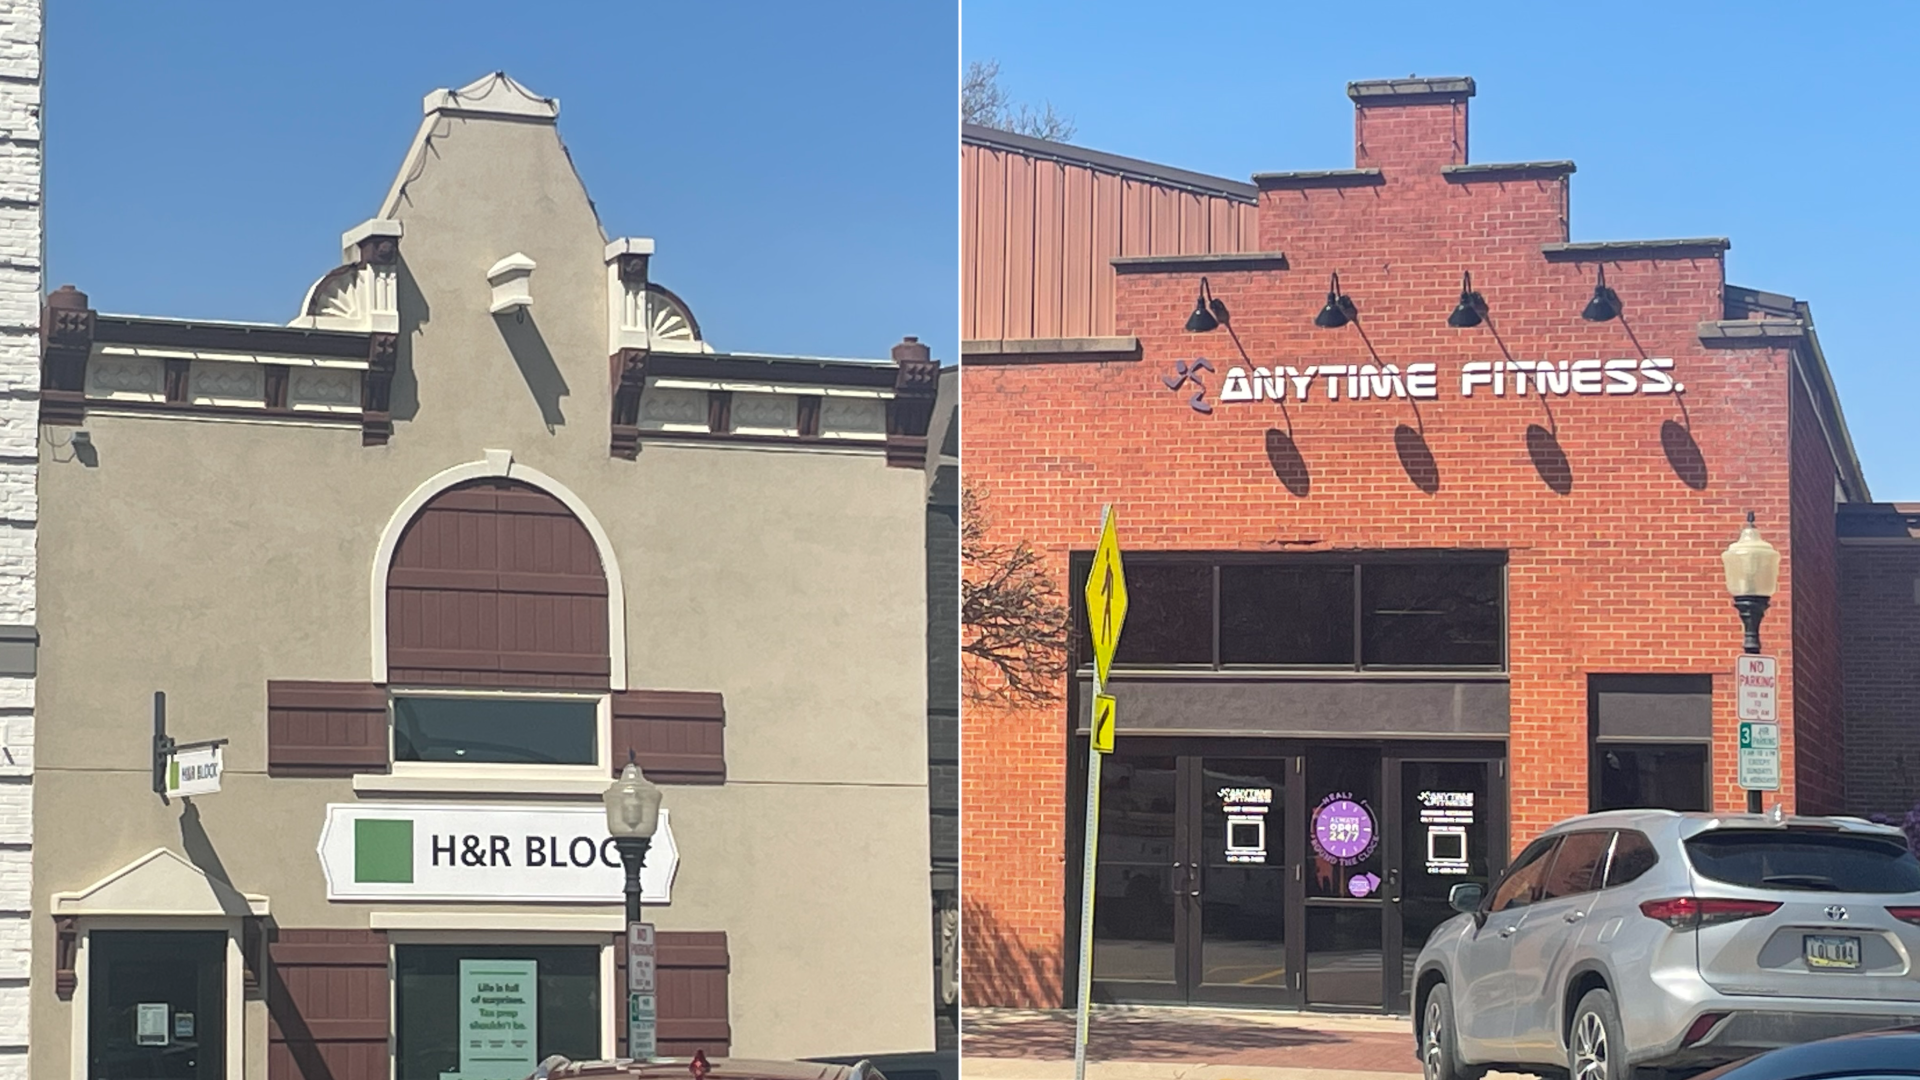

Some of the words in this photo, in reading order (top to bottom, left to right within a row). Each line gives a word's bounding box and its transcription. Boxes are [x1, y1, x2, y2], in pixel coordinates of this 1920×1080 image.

[1220, 362, 1437, 400] ANYTIME
[1749, 661, 1765, 673] NO
[1739, 675, 1775, 688] PARKING
[1741, 727, 1751, 744] 3
[1752, 737, 1776, 745] PARKING
[1329, 823, 1360, 833] open
[1329, 831, 1360, 843] 24/7
[432, 834, 512, 867] H&R
[526, 835, 648, 868] BLOC
[1339, 858, 1358, 866] THE
[1358, 834, 1380, 862] CLOCK
[477, 983, 495, 992] Life
[496, 983, 503, 992] is
[504, 983, 519, 992] full
[470, 995, 481, 1004] of
[479, 1008, 495, 1017] Tax
[496, 1010, 518, 1018] prep
[469, 1021, 511, 1029] shouldn't
